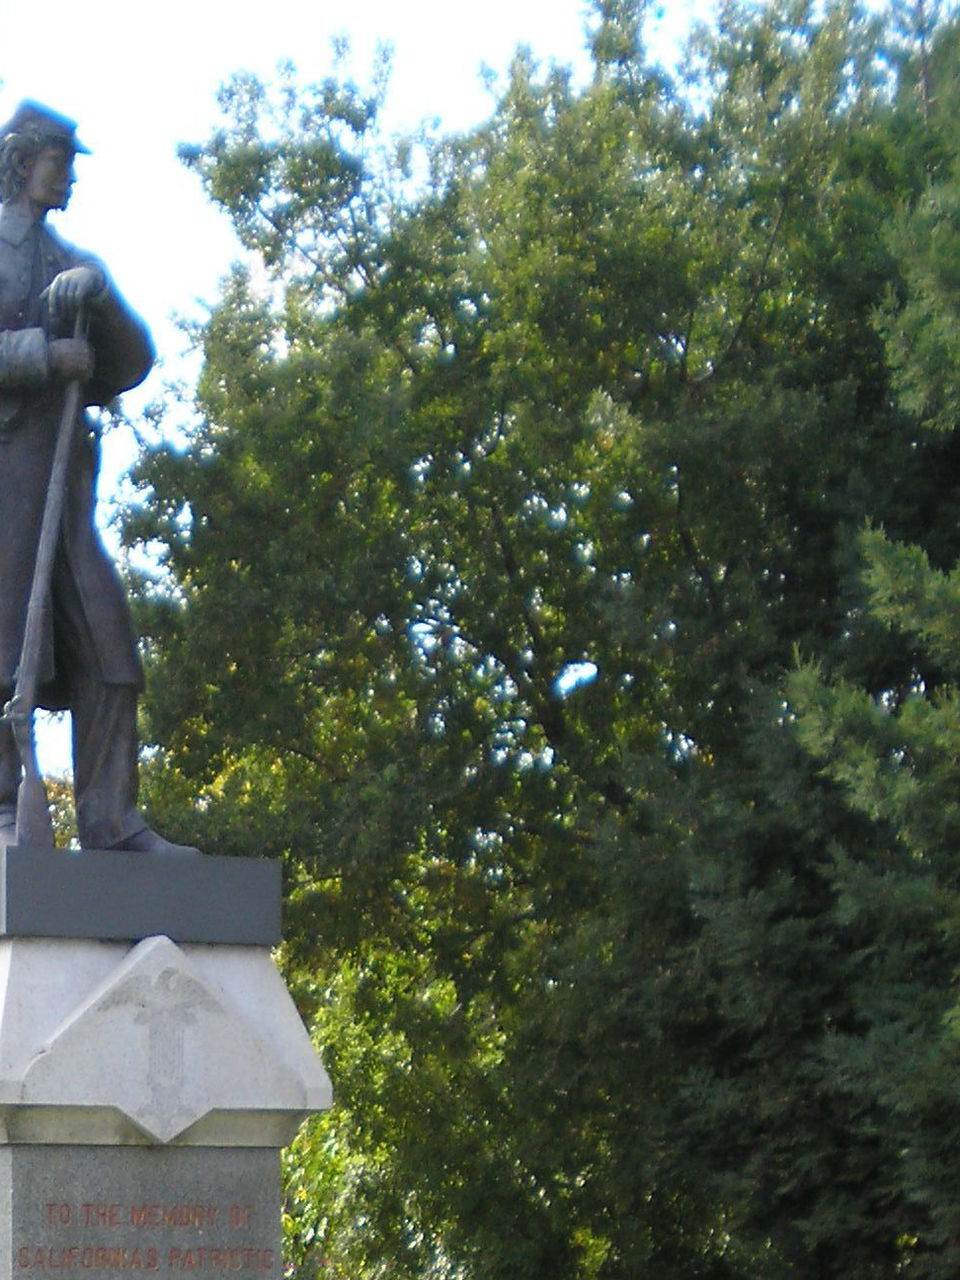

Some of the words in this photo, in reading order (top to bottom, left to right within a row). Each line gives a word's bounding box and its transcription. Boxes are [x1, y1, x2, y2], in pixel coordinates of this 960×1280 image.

[46, 1203, 71, 1227] TO
[83, 1204, 120, 1228] THE
[131, 1204, 219, 1227] MEMORY
[230, 1204, 256, 1226] OF
[168, 1248, 274, 1271] PATRIOTIC
